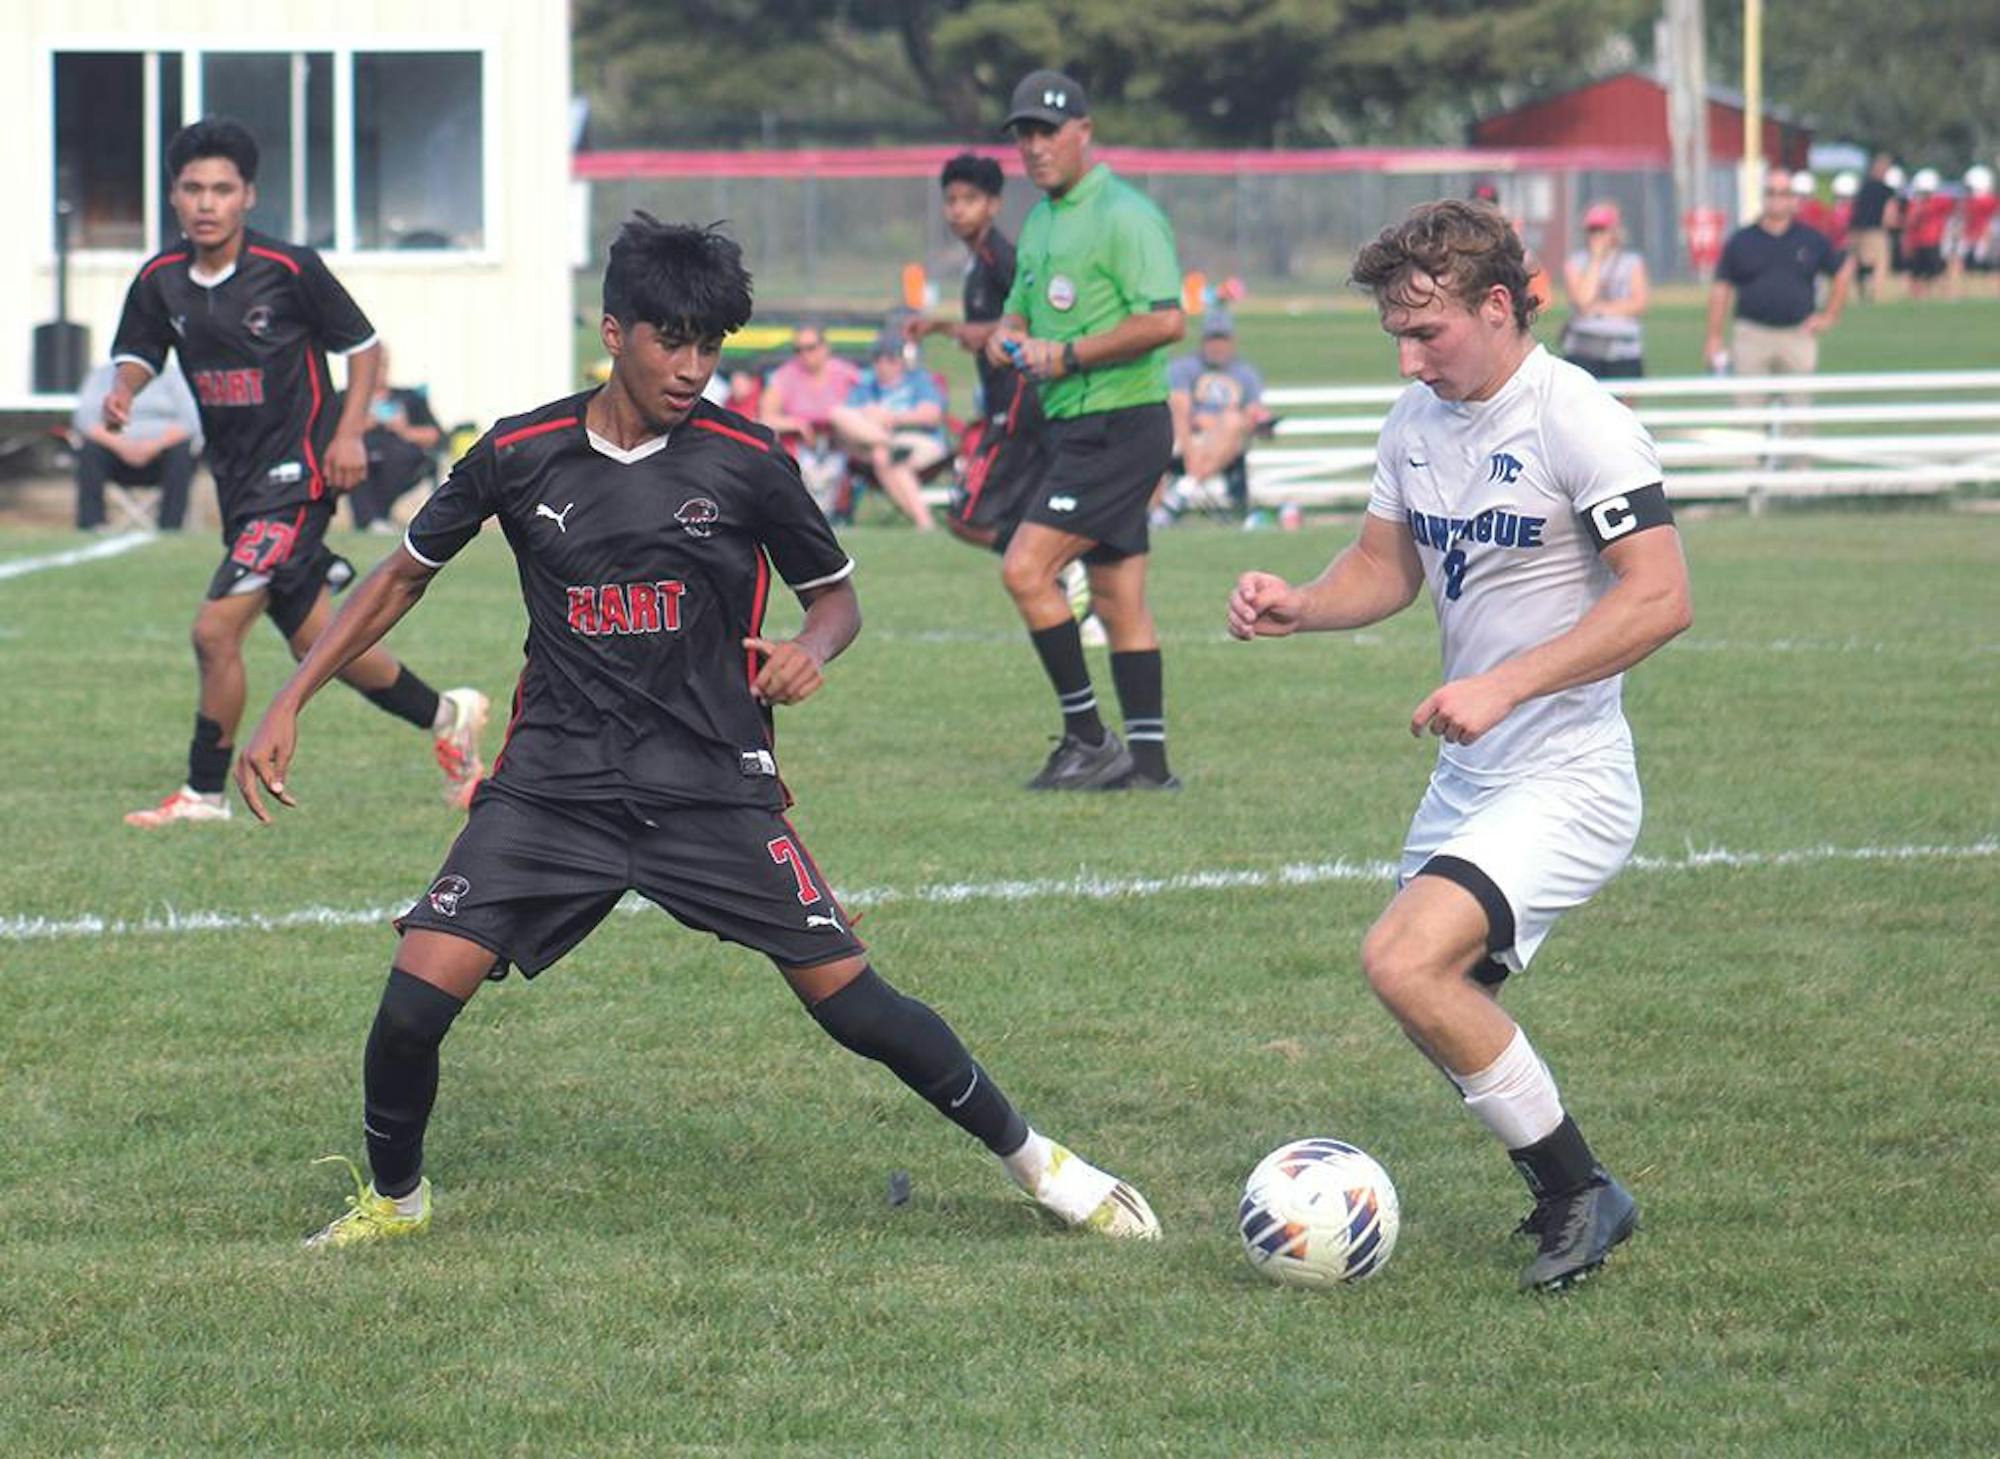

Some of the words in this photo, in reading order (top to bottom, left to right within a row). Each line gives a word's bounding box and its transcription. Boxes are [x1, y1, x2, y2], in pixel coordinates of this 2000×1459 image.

[194, 368, 264, 406] HART
[1591, 495, 1638, 541] C
[232, 519, 296, 571] 27
[566, 581, 686, 635] HART
[768, 835, 821, 905] 7
